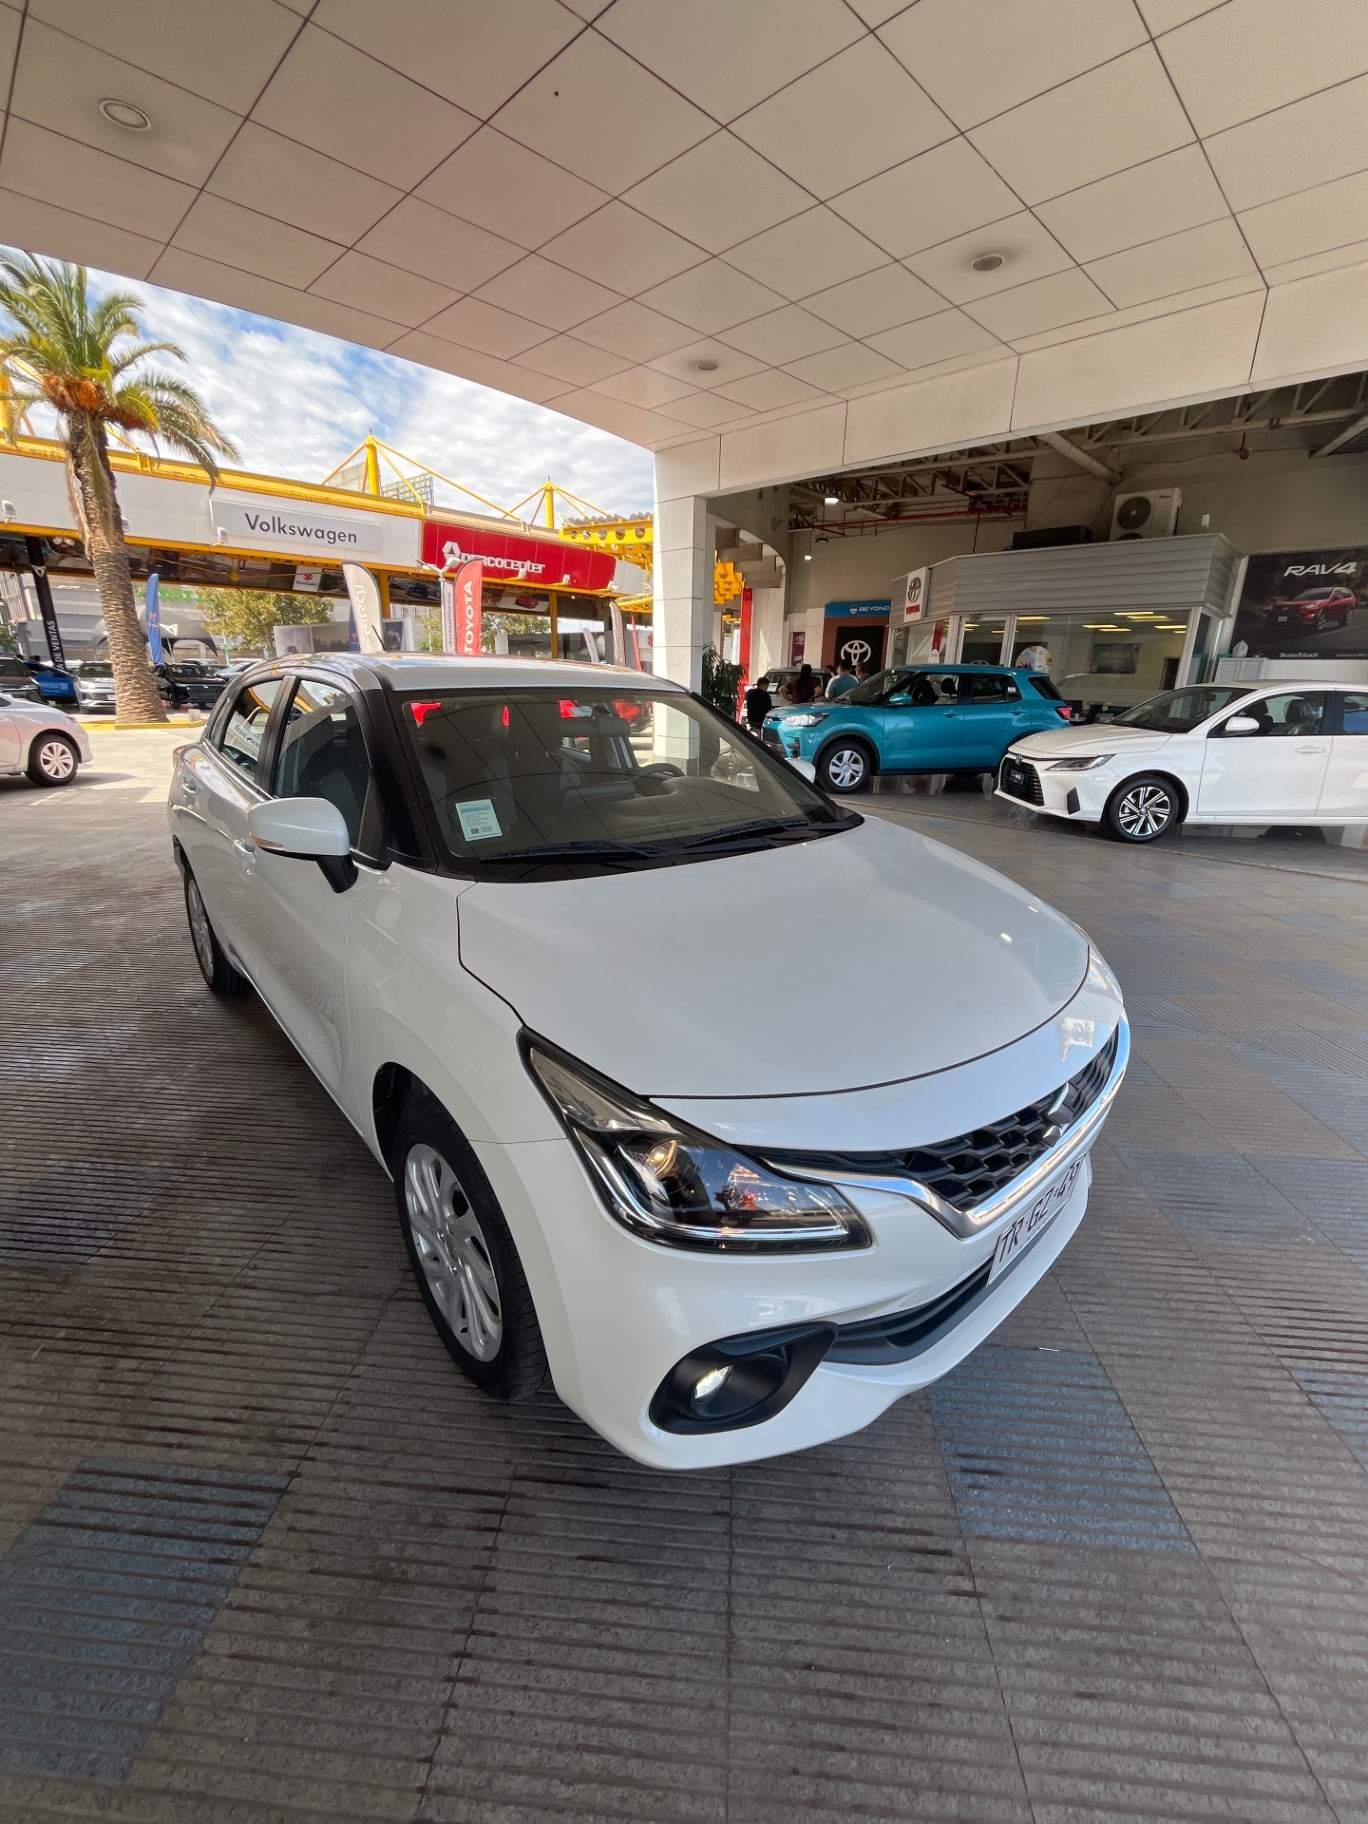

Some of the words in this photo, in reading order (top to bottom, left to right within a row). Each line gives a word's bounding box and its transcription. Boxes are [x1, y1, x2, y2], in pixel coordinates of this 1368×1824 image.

[245, 513, 357, 544] Volkswagen
[1284, 562, 1358, 577] RAV4
[464, 580, 474, 655] TOYOTA
[47, 620, 60, 651] VENTAS
